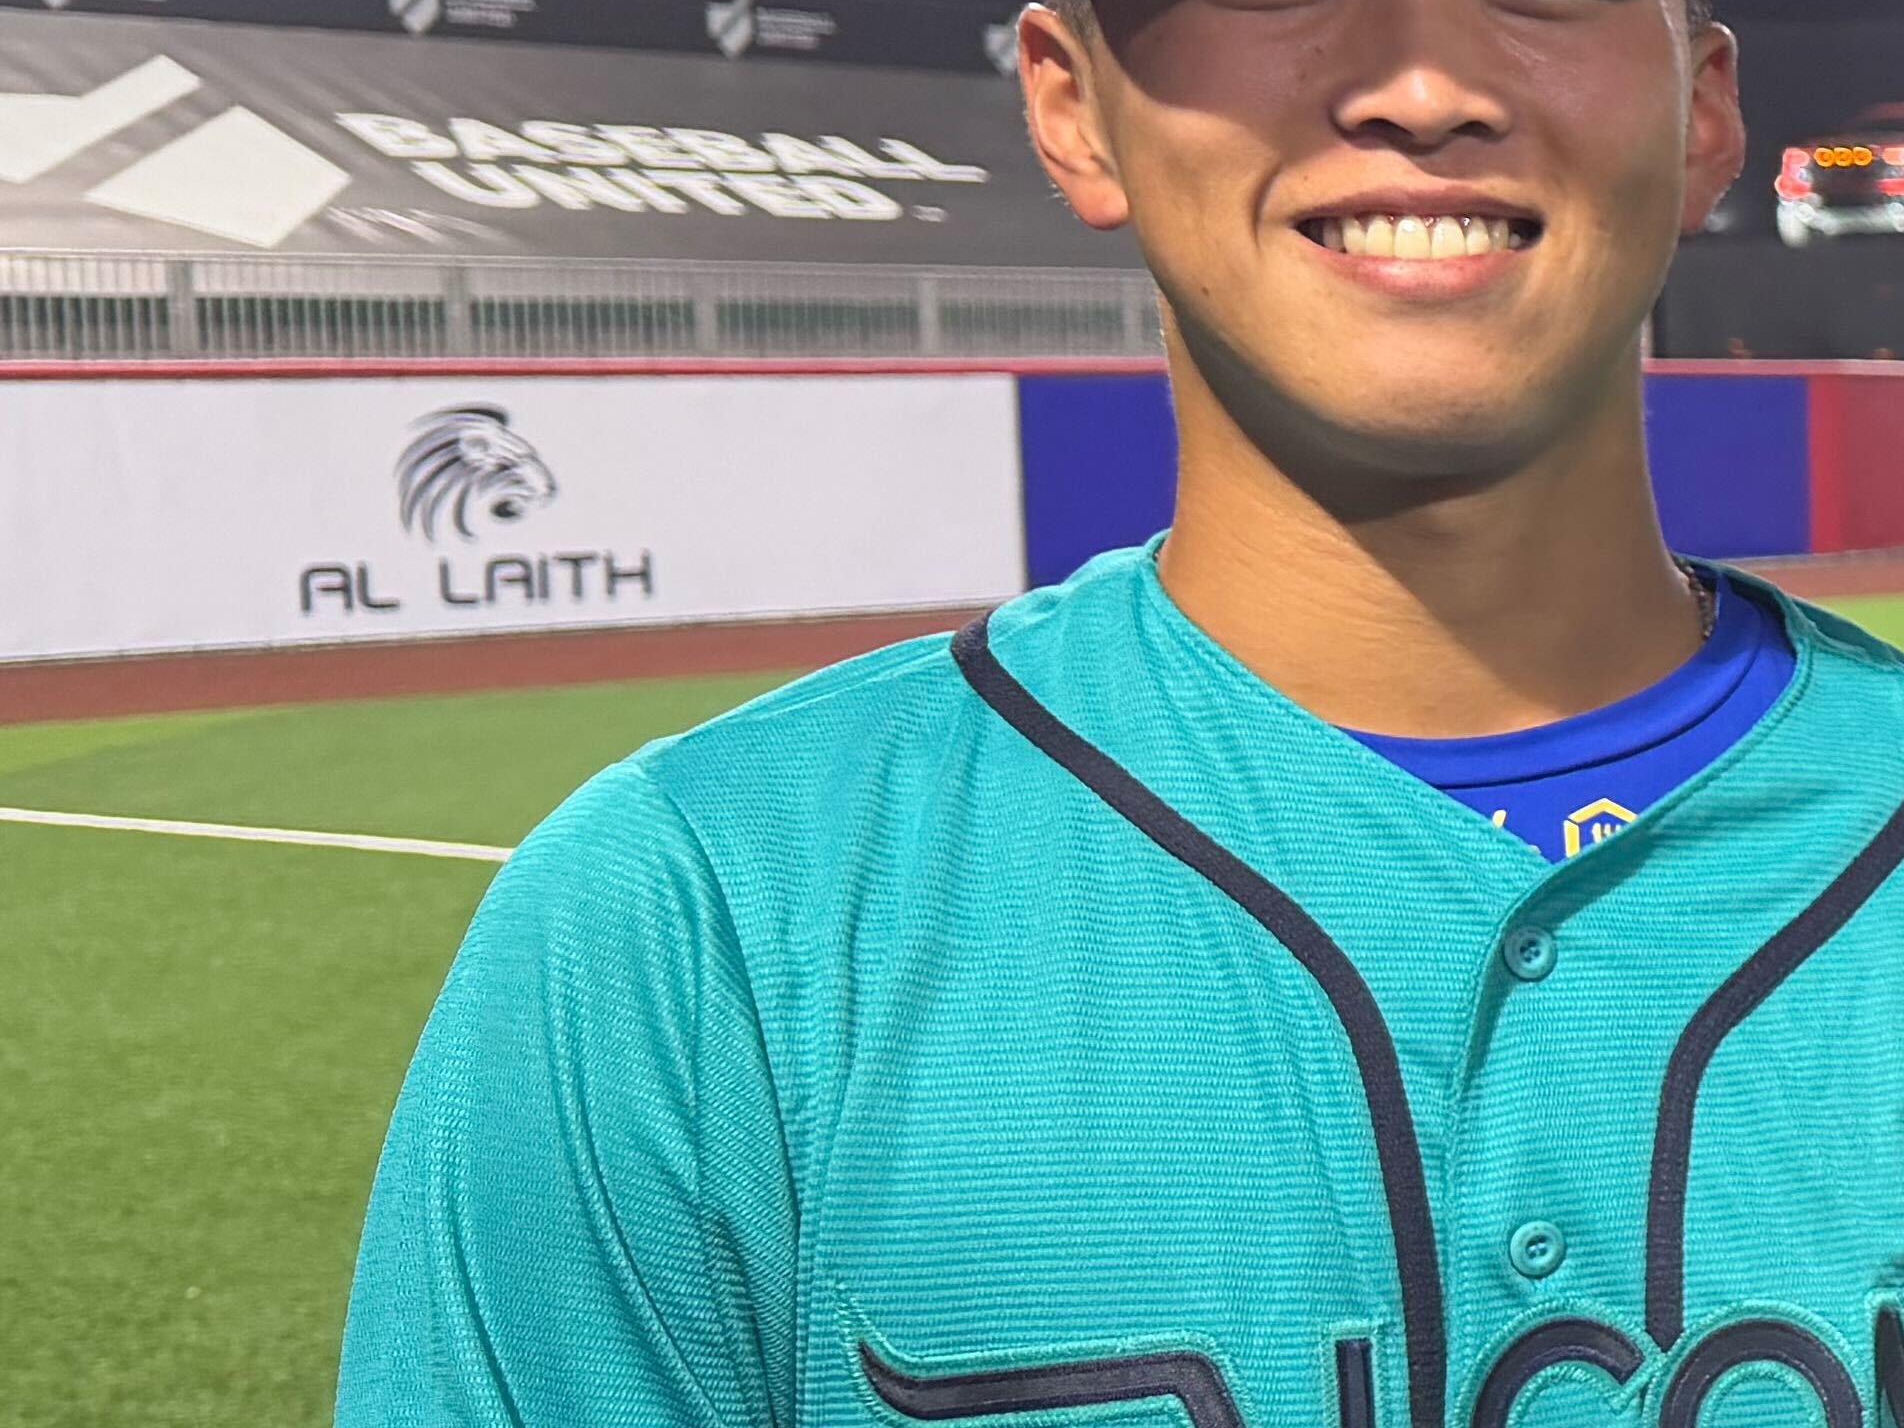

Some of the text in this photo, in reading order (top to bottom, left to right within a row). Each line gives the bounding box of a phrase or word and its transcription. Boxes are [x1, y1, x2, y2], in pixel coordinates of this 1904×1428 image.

[333, 111, 989, 183] BASEBALL
[408, 158, 903, 221] UNITED
[299, 550, 655, 616] AL LAITH
